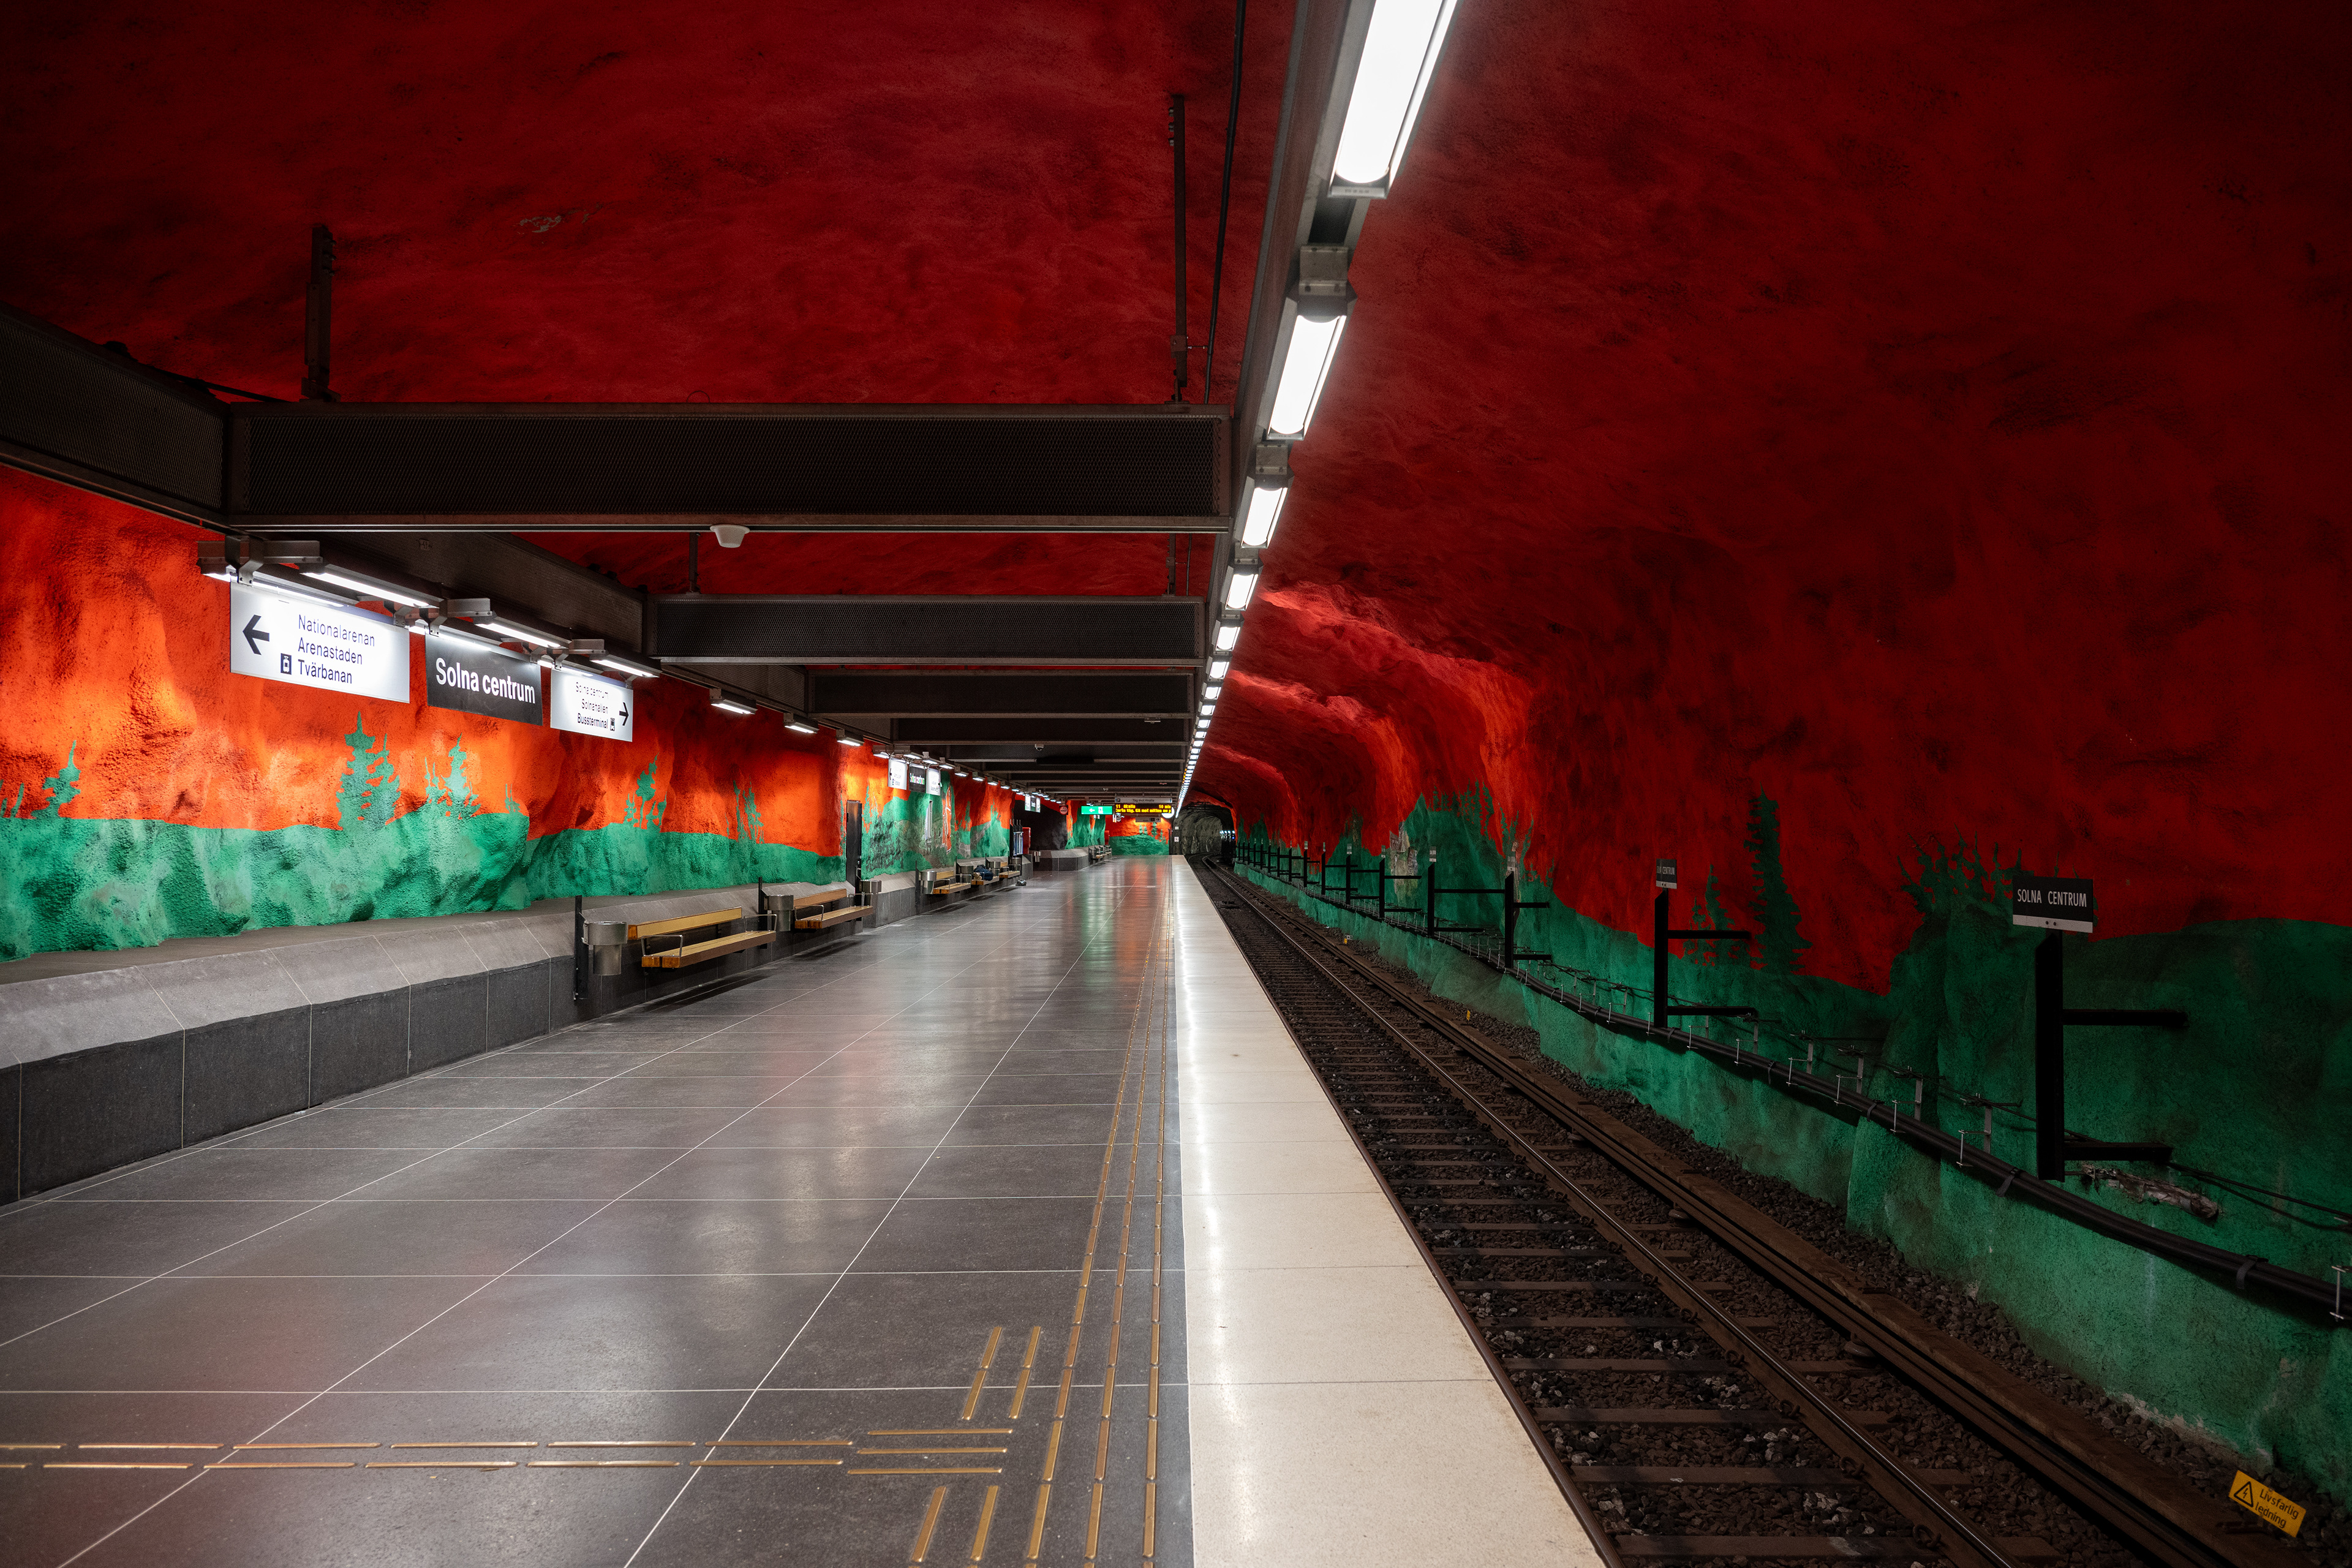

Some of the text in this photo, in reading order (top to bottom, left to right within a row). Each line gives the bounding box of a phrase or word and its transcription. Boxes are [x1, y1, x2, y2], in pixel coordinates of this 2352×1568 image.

[298, 614, 375, 647] Nationalarenan
[298, 637, 363, 665] Arenastaden
[298, 659, 352, 684] Tvärbanan
[435, 657, 536, 704] Solna centrum
[576, 682, 589, 695] Sona
[577, 712, 608, 729] Bussterminal
[2017, 889, 2087, 907] SOLNA CENTRUM
[2255, 1502, 2286, 1529] ledning
[2260, 1489, 2299, 1520] Livsfarlig
